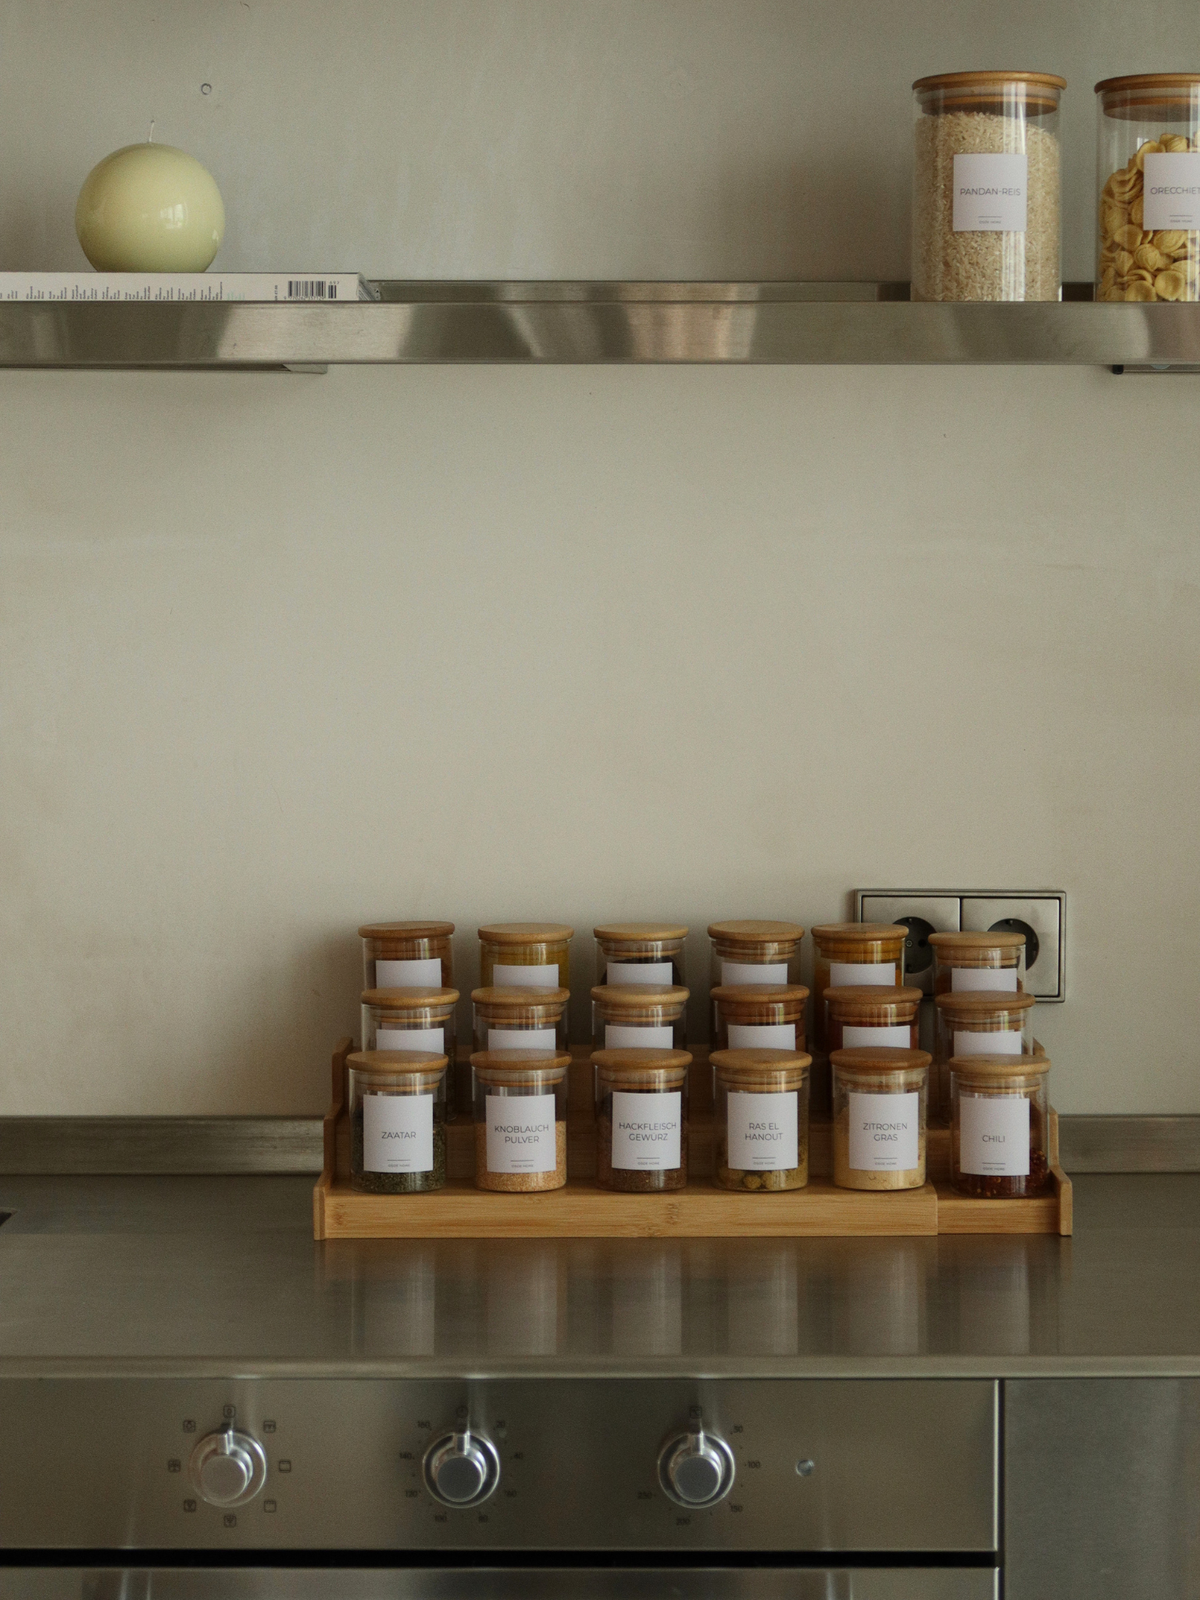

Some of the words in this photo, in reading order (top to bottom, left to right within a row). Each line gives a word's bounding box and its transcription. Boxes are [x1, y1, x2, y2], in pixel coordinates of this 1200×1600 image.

[960, 187, 1021, 196] PANDAN-REIS
[494, 1124, 549, 1133] KNOBLAUCH
[618, 1122, 677, 1131] HACKFLEISCH
[748, 1122, 766, 1131] RAS
[768, 1122, 779, 1130] EL
[863, 1122, 908, 1131] ZITRONEN
[504, 1135, 540, 1144] PULVER
[744, 1133, 783, 1142] HANOUT
[873, 1133, 899, 1142] GRAS
[981, 1134, 1006, 1143] CHILI
[747, 1460, 762, 1469] 100
